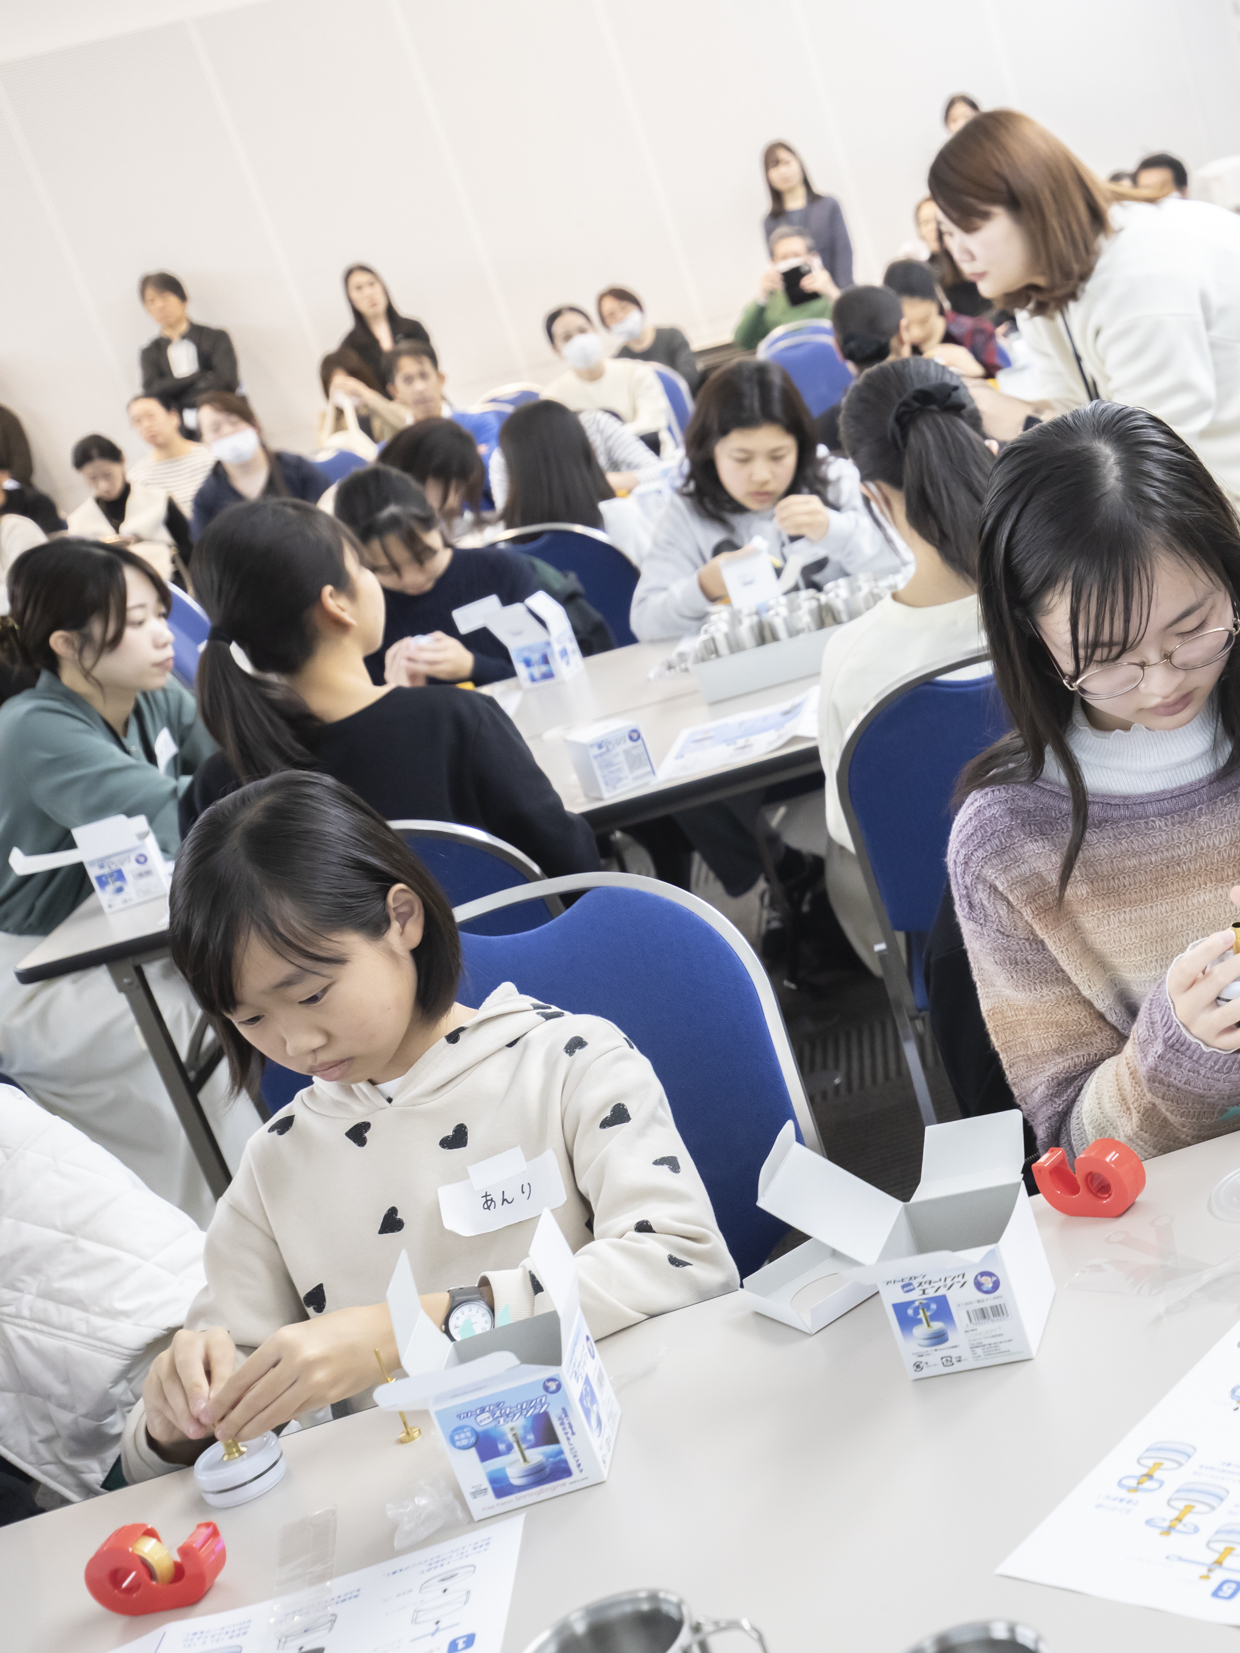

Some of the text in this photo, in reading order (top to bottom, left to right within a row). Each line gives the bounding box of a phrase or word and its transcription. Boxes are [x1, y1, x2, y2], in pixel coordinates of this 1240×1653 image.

[480, 1182, 532, 1211] あんり
[916, 1272, 966, 1289] スターリング
[918, 1280, 968, 1297] エンジン
[493, 1394, 547, 1418] スターリング
[1217, 1581, 1238, 1597] 5
